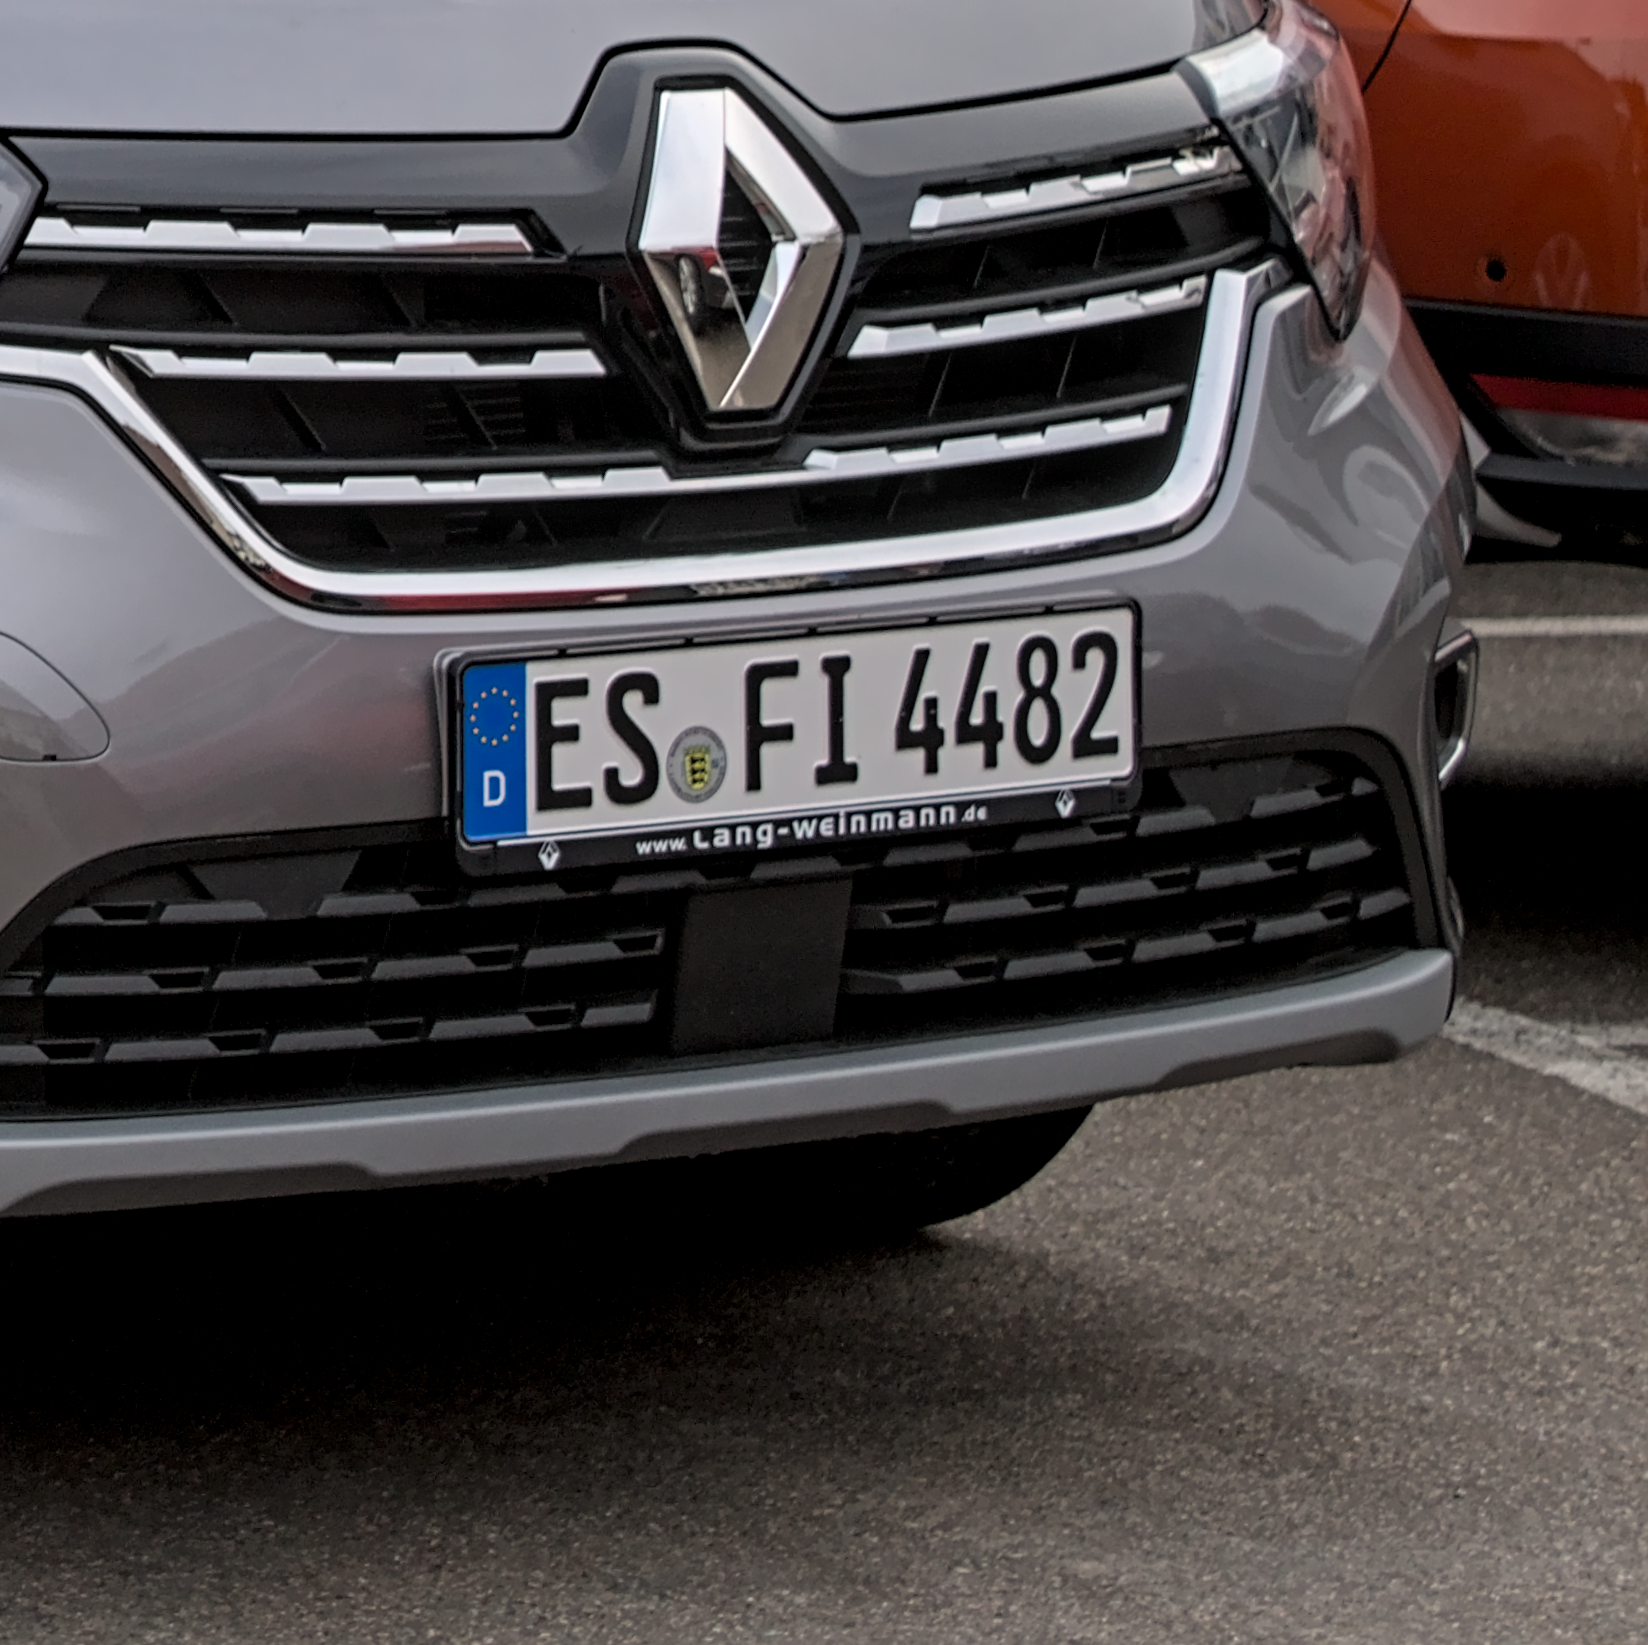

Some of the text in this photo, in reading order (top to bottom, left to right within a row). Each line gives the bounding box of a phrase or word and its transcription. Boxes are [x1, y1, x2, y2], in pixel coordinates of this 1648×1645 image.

[534, 670, 662, 813] ES
[744, 653, 859, 792] FI
[894, 630, 1120, 776] 4482
[482, 769, 507, 808] D
